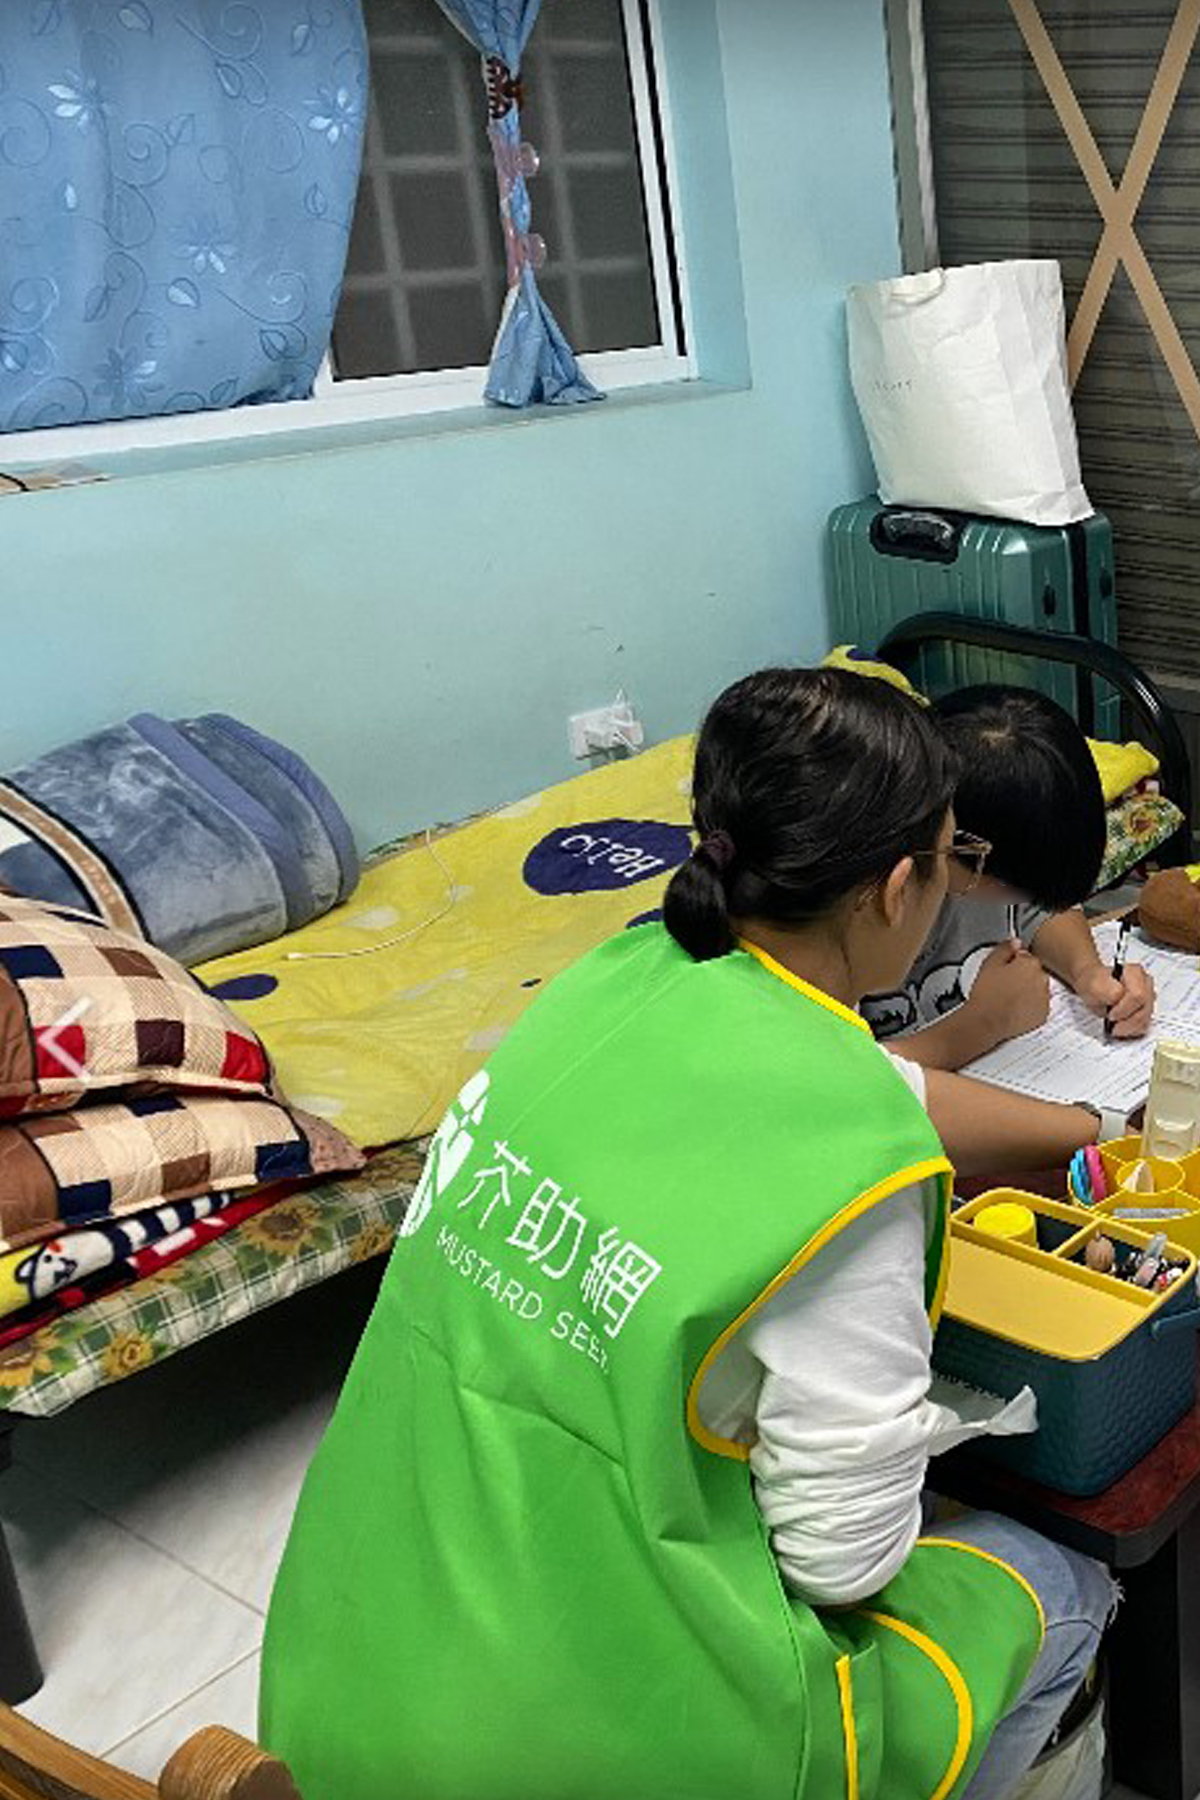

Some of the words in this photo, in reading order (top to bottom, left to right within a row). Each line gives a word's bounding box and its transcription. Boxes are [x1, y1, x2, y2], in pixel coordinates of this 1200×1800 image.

[436, 1224, 543, 1320] MUSTARD
[457, 1140, 662, 1339] 芥助網
